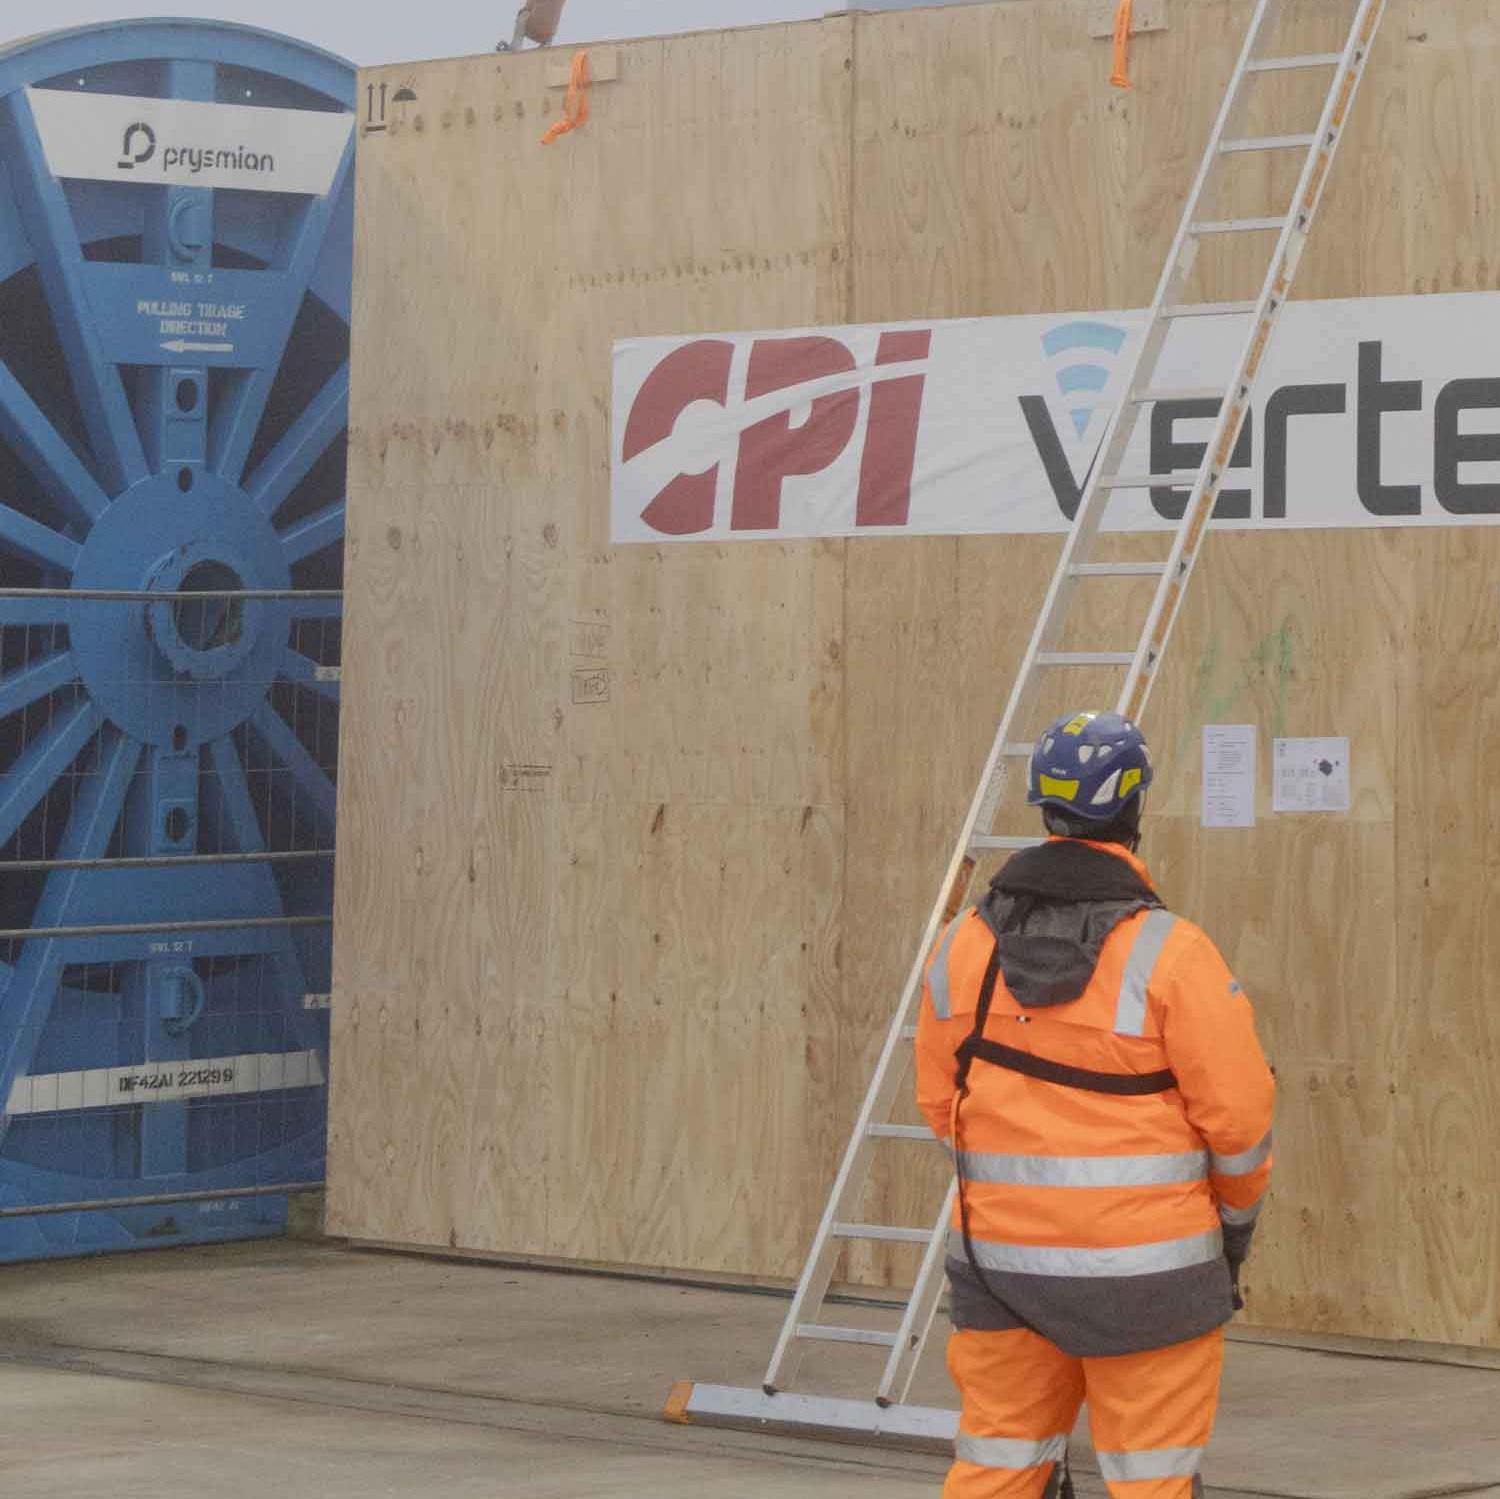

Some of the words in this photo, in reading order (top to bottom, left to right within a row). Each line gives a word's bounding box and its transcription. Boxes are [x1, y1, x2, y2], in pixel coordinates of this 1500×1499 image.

[163, 145, 275, 173] prysmian
[137, 301, 192, 316] PULLING
[160, 319, 226, 337] DIRECTION
